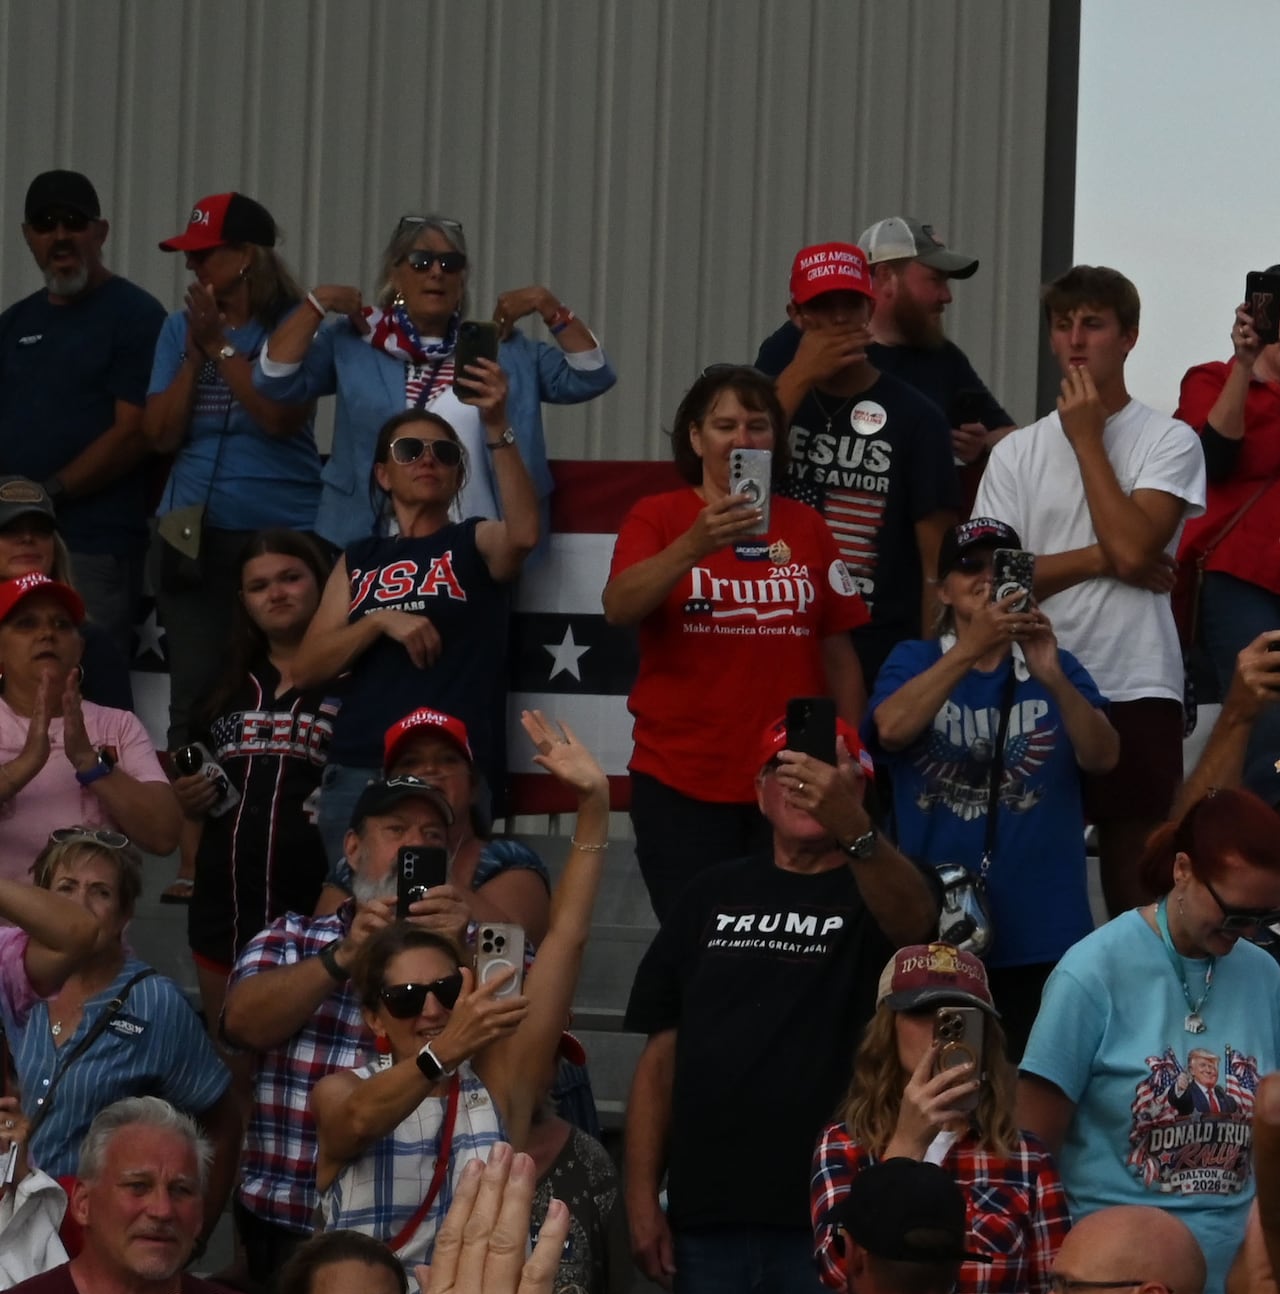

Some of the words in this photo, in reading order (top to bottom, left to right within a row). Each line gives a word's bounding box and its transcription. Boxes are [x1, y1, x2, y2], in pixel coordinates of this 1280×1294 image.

[800, 252, 826, 270] MAKE
[808, 264, 836, 281] GREAT
[788, 424, 892, 473] ESUS
[814, 467, 890, 493] SAVIOR
[349, 549, 468, 615] USA
[767, 564, 809, 579] 2024
[688, 566, 815, 614] Trump
[683, 624, 711, 633] Make
[713, 624, 757, 635] America
[758, 625, 786, 635] Great
[211, 710, 335, 767] MERIC
[934, 699, 1049, 757] RUMP
[716, 912, 844, 936] TRUMP
[728, 939, 766, 948] AMERICA
[768, 940, 801, 953] GREAT
[802, 944, 828, 955] AGAI
[1150, 1121, 1215, 1153] DONALD
[1217, 1120, 1252, 1148] TRUM
